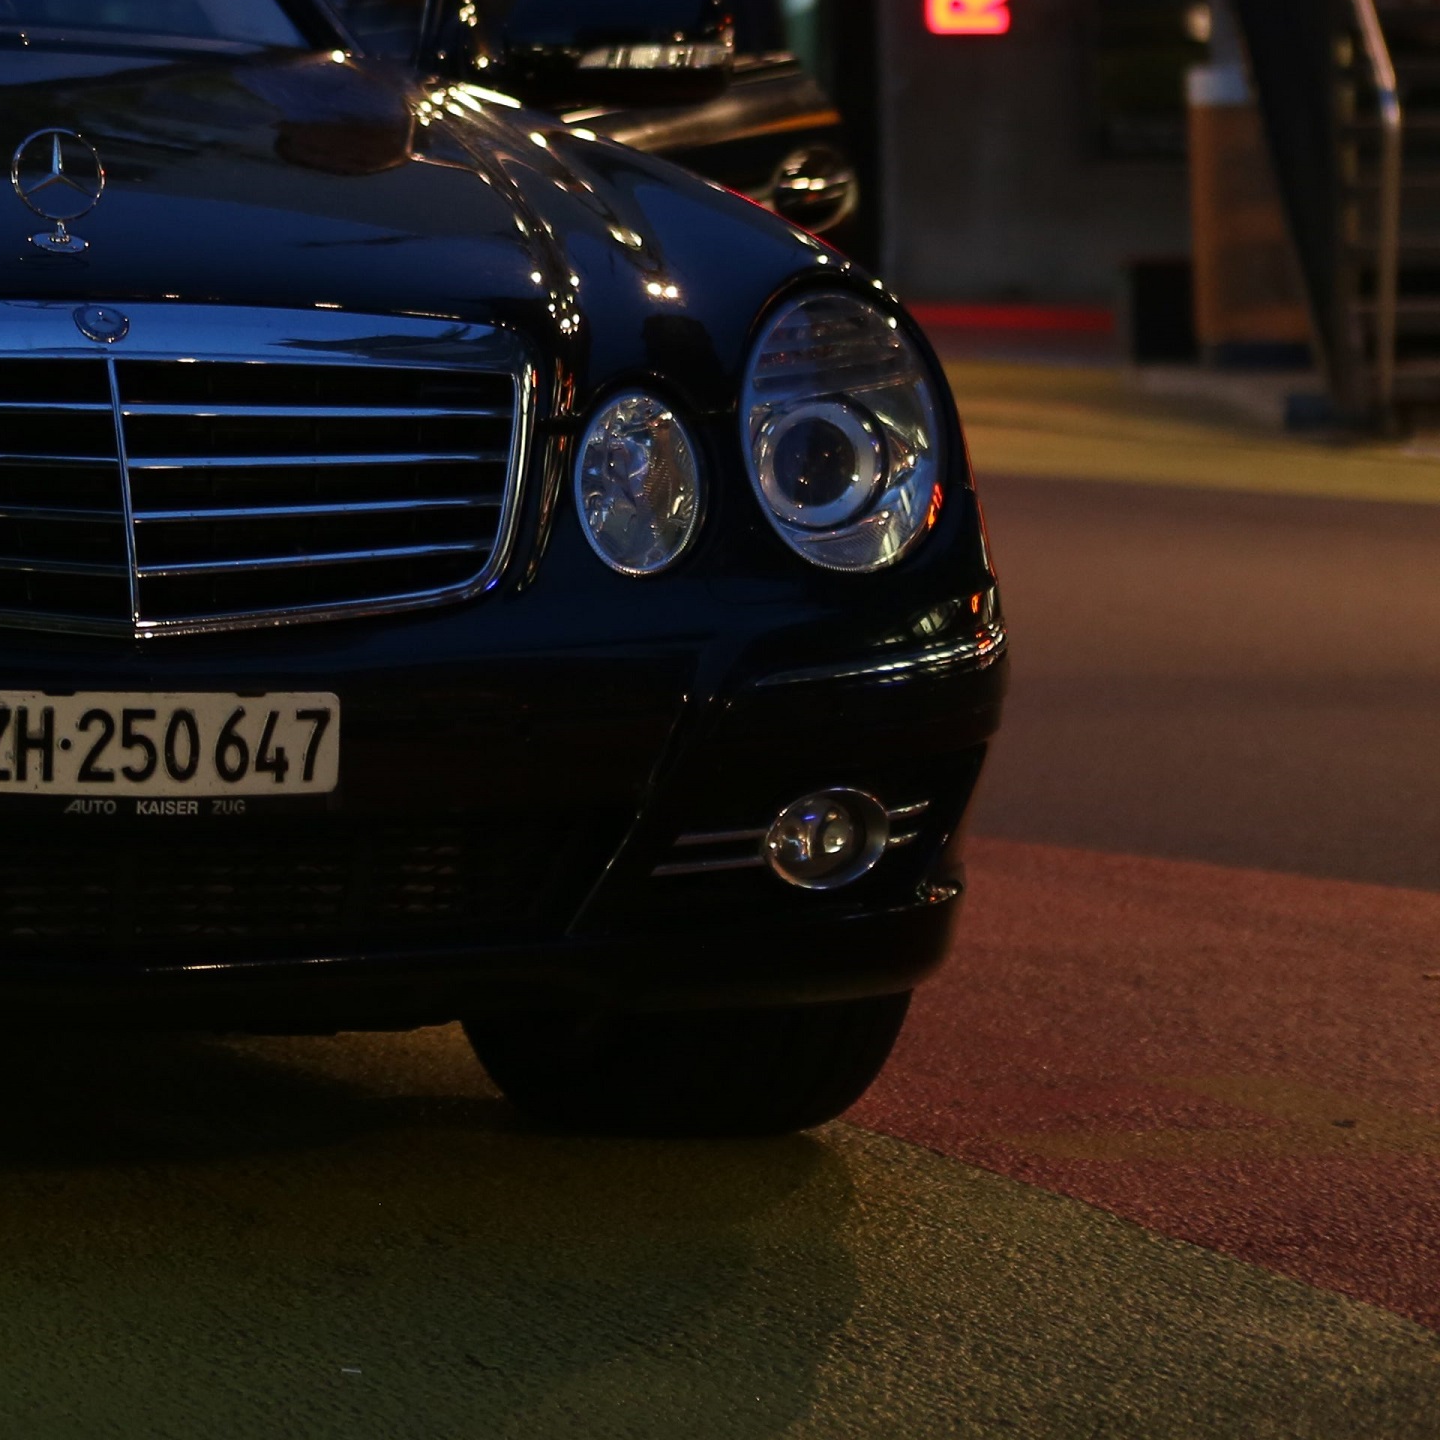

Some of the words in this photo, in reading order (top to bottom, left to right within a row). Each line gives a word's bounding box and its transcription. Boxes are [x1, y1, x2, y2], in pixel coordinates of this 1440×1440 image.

[63, 799, 118, 816] AUTO
[135, 799, 199, 816] KAISER
[211, 799, 247, 816] ZUG
